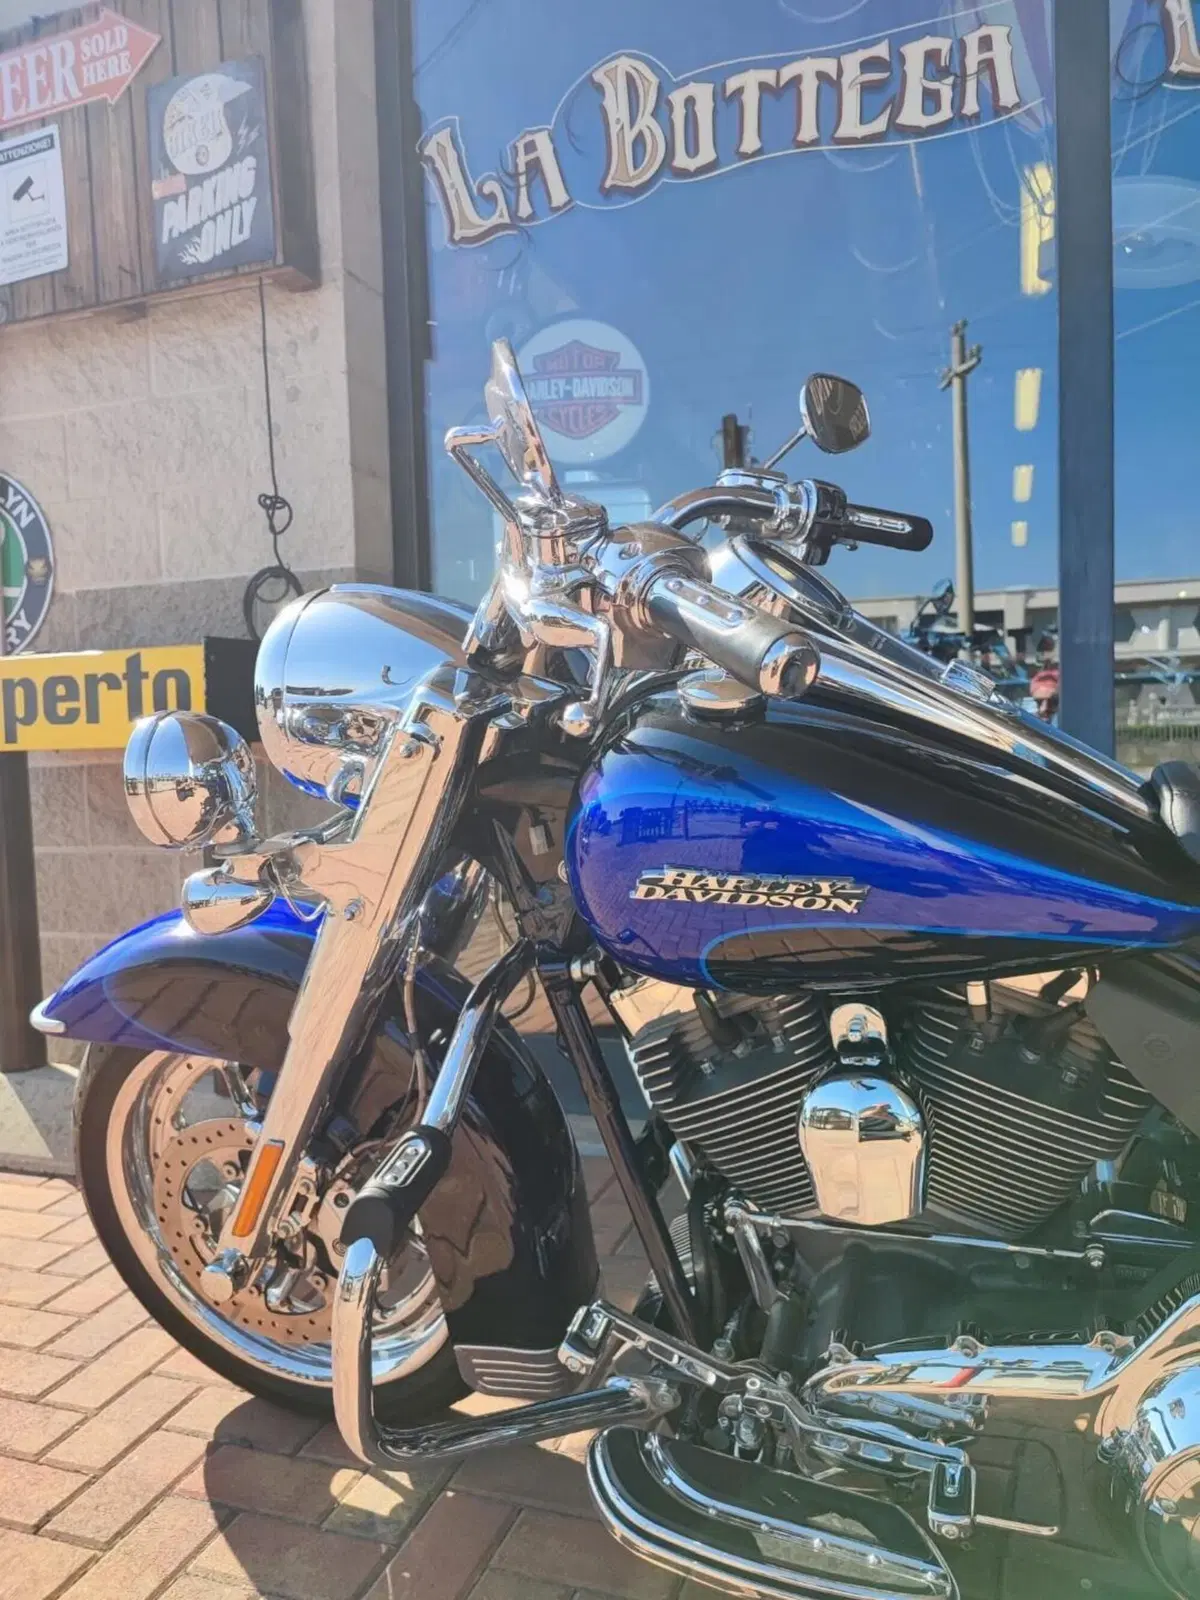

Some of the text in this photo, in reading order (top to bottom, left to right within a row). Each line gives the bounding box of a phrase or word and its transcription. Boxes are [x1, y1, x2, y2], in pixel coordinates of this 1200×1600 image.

[80, 25, 129, 62] SOLD
[82, 51, 132, 87] HERE
[0, 39, 84, 121] EER
[423, 127, 575, 245] LA
[591, 24, 1022, 198] BOTTEGA
[162, 155, 257, 244] PARKING
[198, 196, 257, 264] ONLY
[2, 652, 192, 744] perto
[631, 884, 863, 914] DAVIDSON
[658, 866, 853, 897] HARLEY
